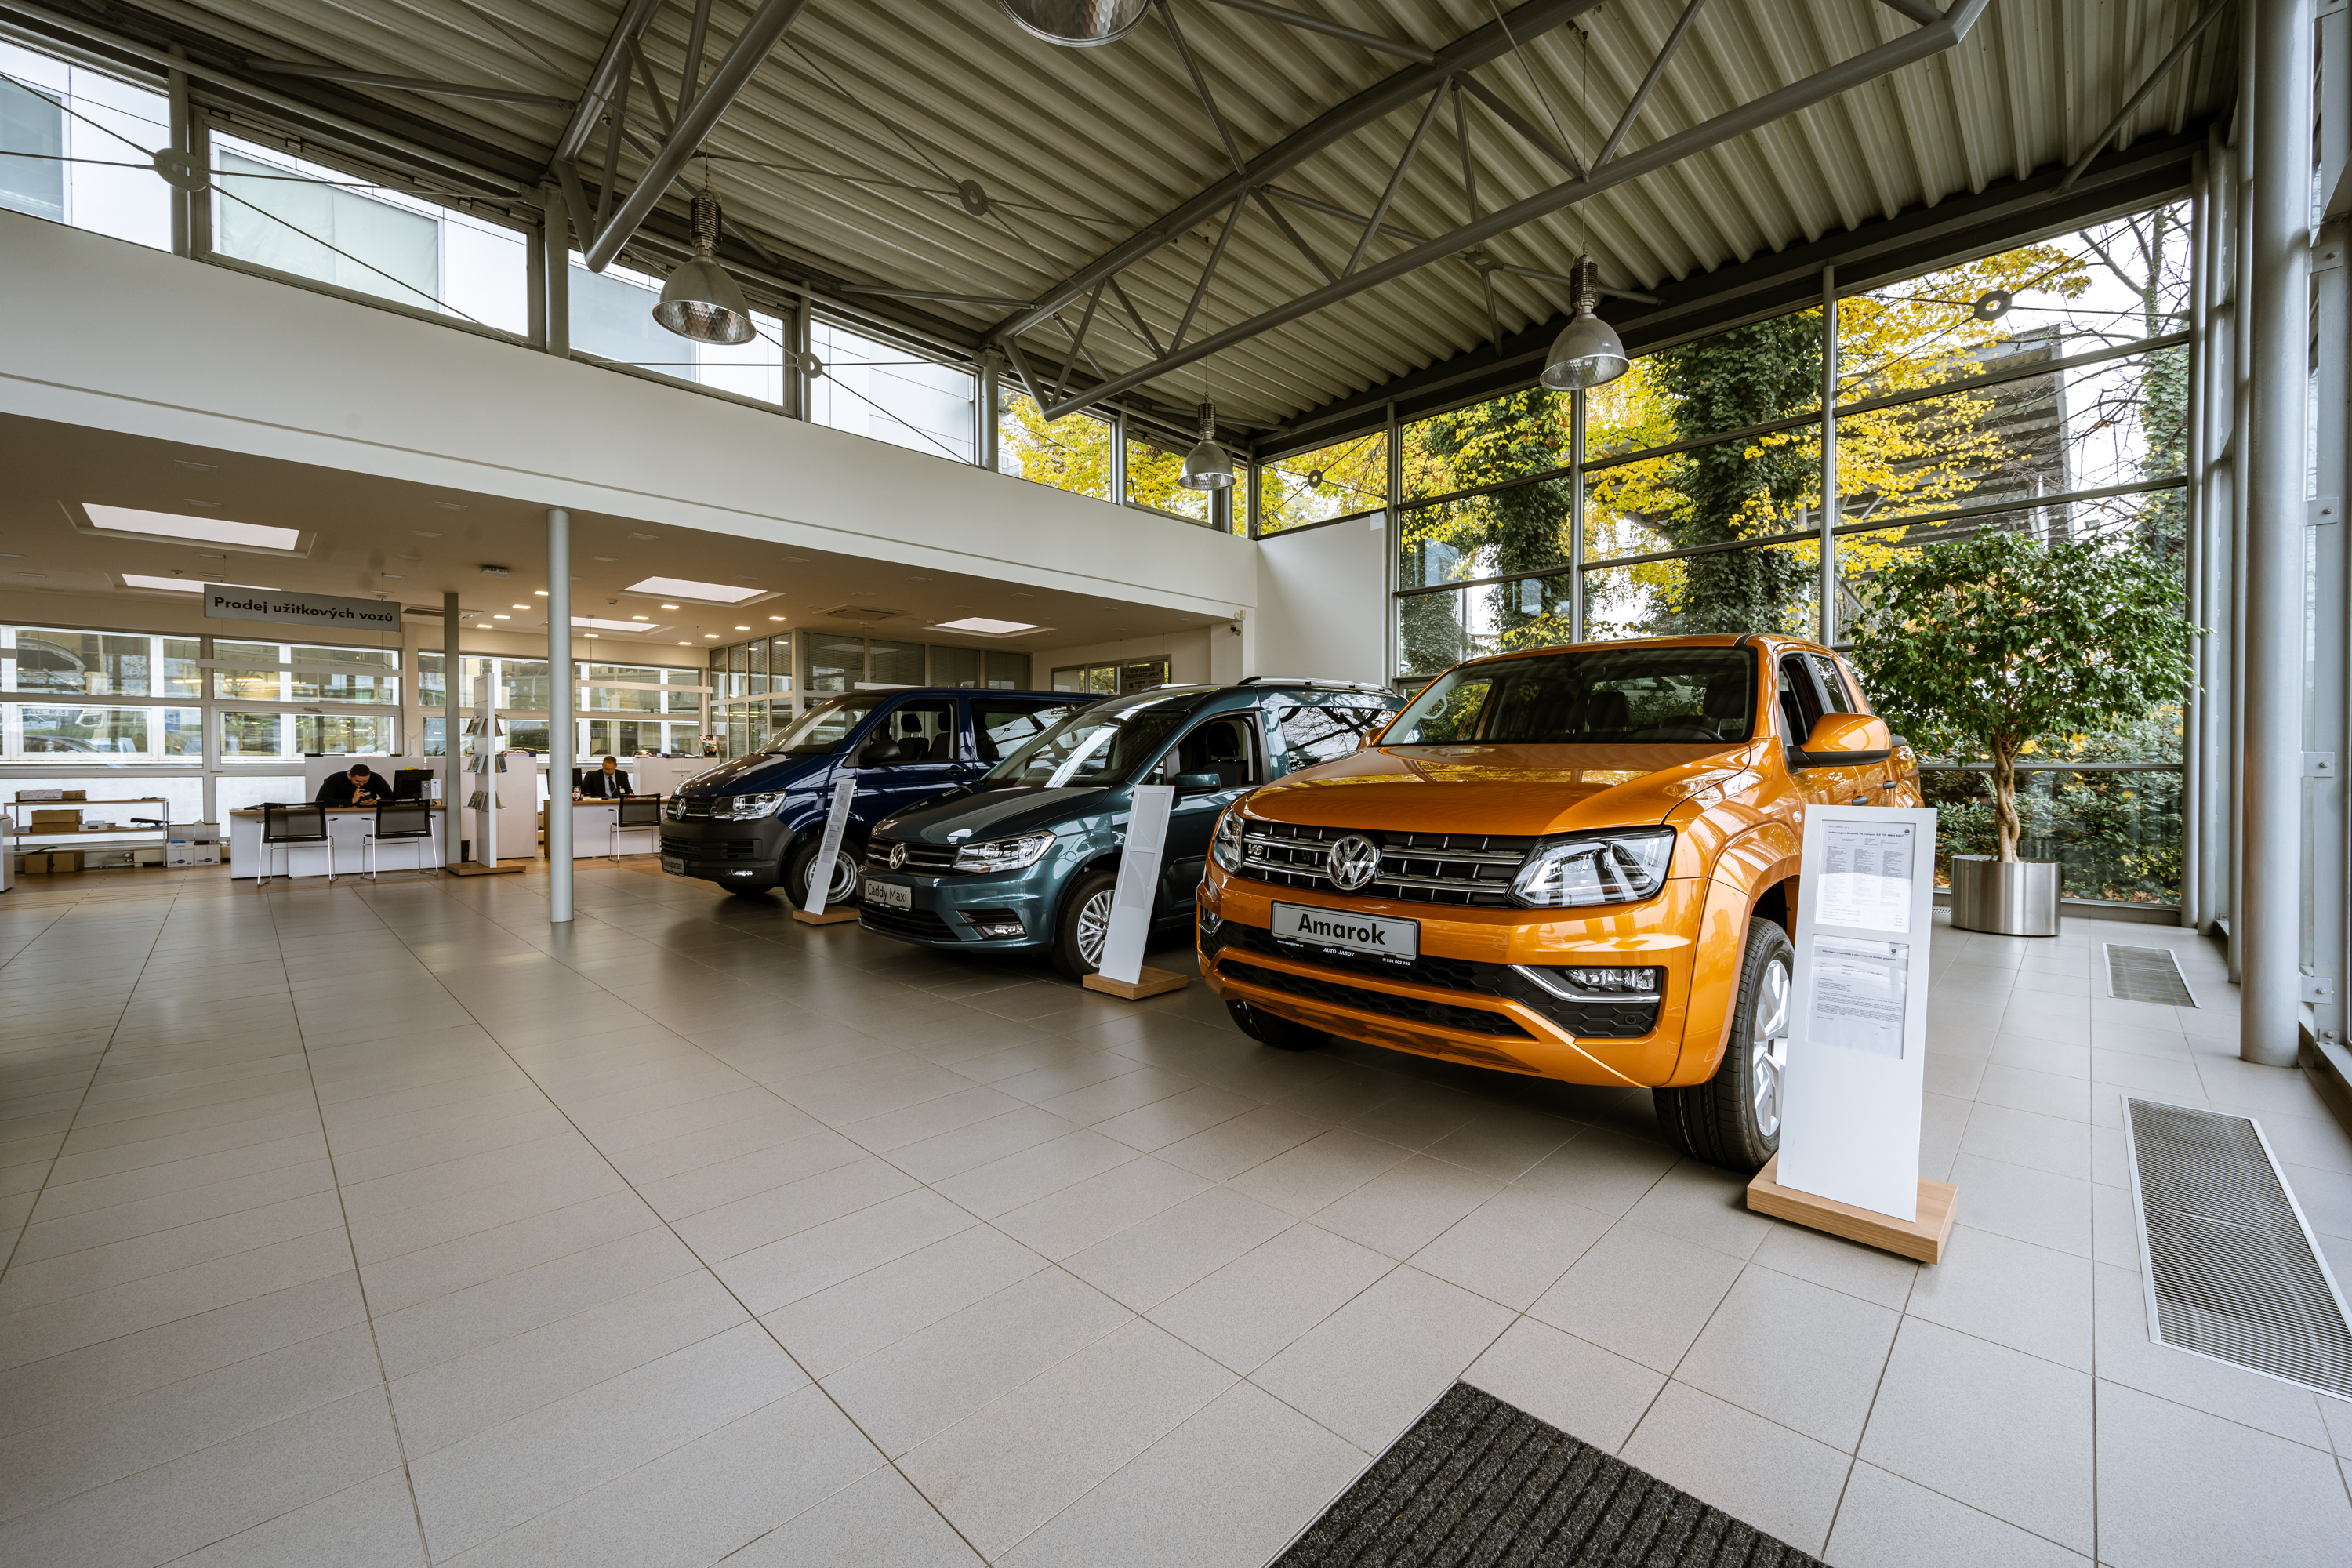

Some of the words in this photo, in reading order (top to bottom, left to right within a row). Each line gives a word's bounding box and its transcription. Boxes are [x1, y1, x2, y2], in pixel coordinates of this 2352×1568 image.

[214, 597, 267, 614] Prodej
[273, 603, 354, 619] užitkových
[358, 612, 393, 622] vozů
[1247, 843, 1264, 855] V6
[867, 883, 888, 902] Caddy
[889, 887, 907, 903] Maxi
[1298, 913, 1386, 946] Amarok
